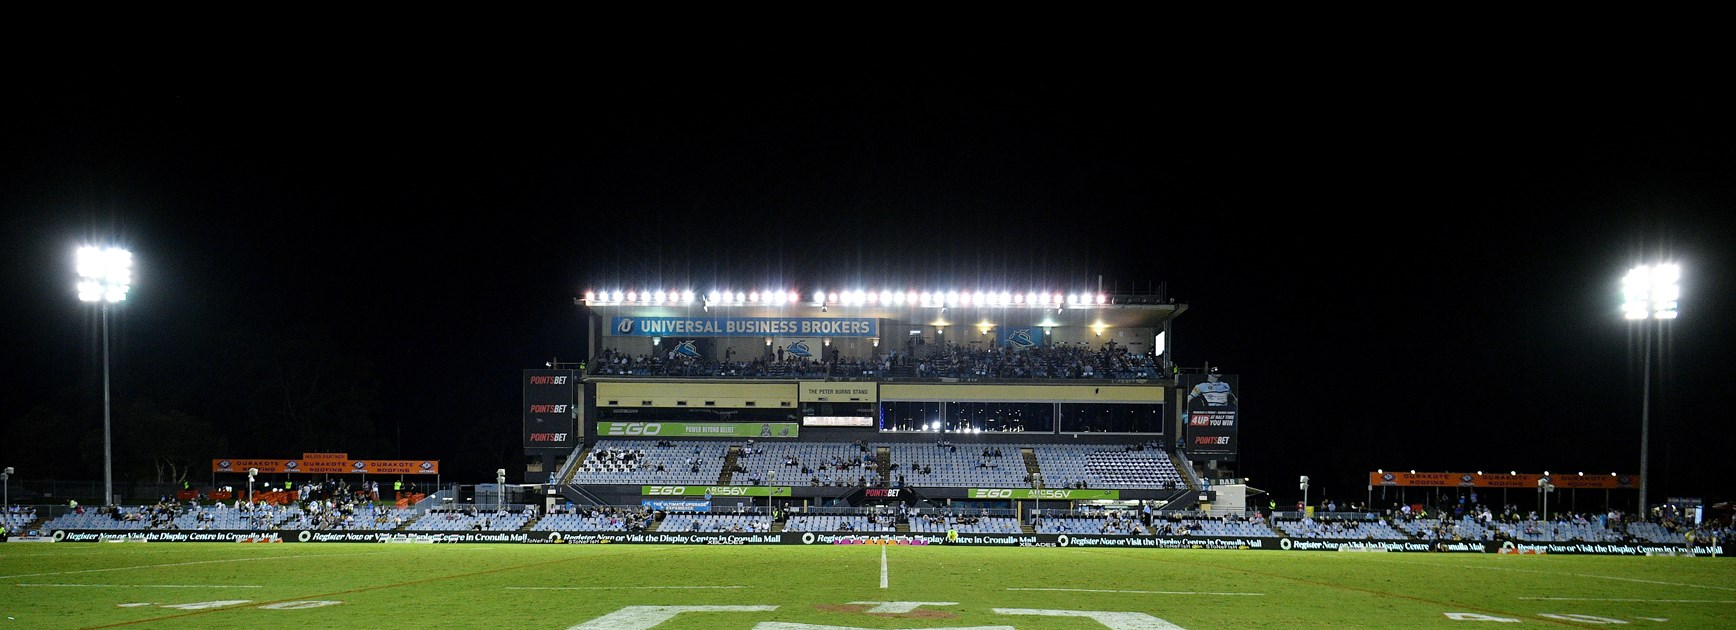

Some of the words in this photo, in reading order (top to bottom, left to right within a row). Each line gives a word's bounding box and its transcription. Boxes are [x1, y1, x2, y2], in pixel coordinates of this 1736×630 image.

[641, 320, 722, 333] UNIVERSAL
[726, 320, 798, 333] BUSINESS
[801, 321, 870, 333] BROKERS
[530, 376, 568, 385] POINTSBET
[530, 405, 568, 413] POINTSBET
[1191, 416, 1210, 425] 4UP
[608, 422, 662, 436] EGO
[530, 433, 568, 442] POINTSBET
[1194, 436, 1230, 445] POINTSBET
[649, 486, 686, 495] EGO
[723, 487, 748, 495] 56V
[865, 488, 900, 497] POINTSBET
[975, 489, 1012, 498] EGO
[1046, 490, 1071, 498] 56V
